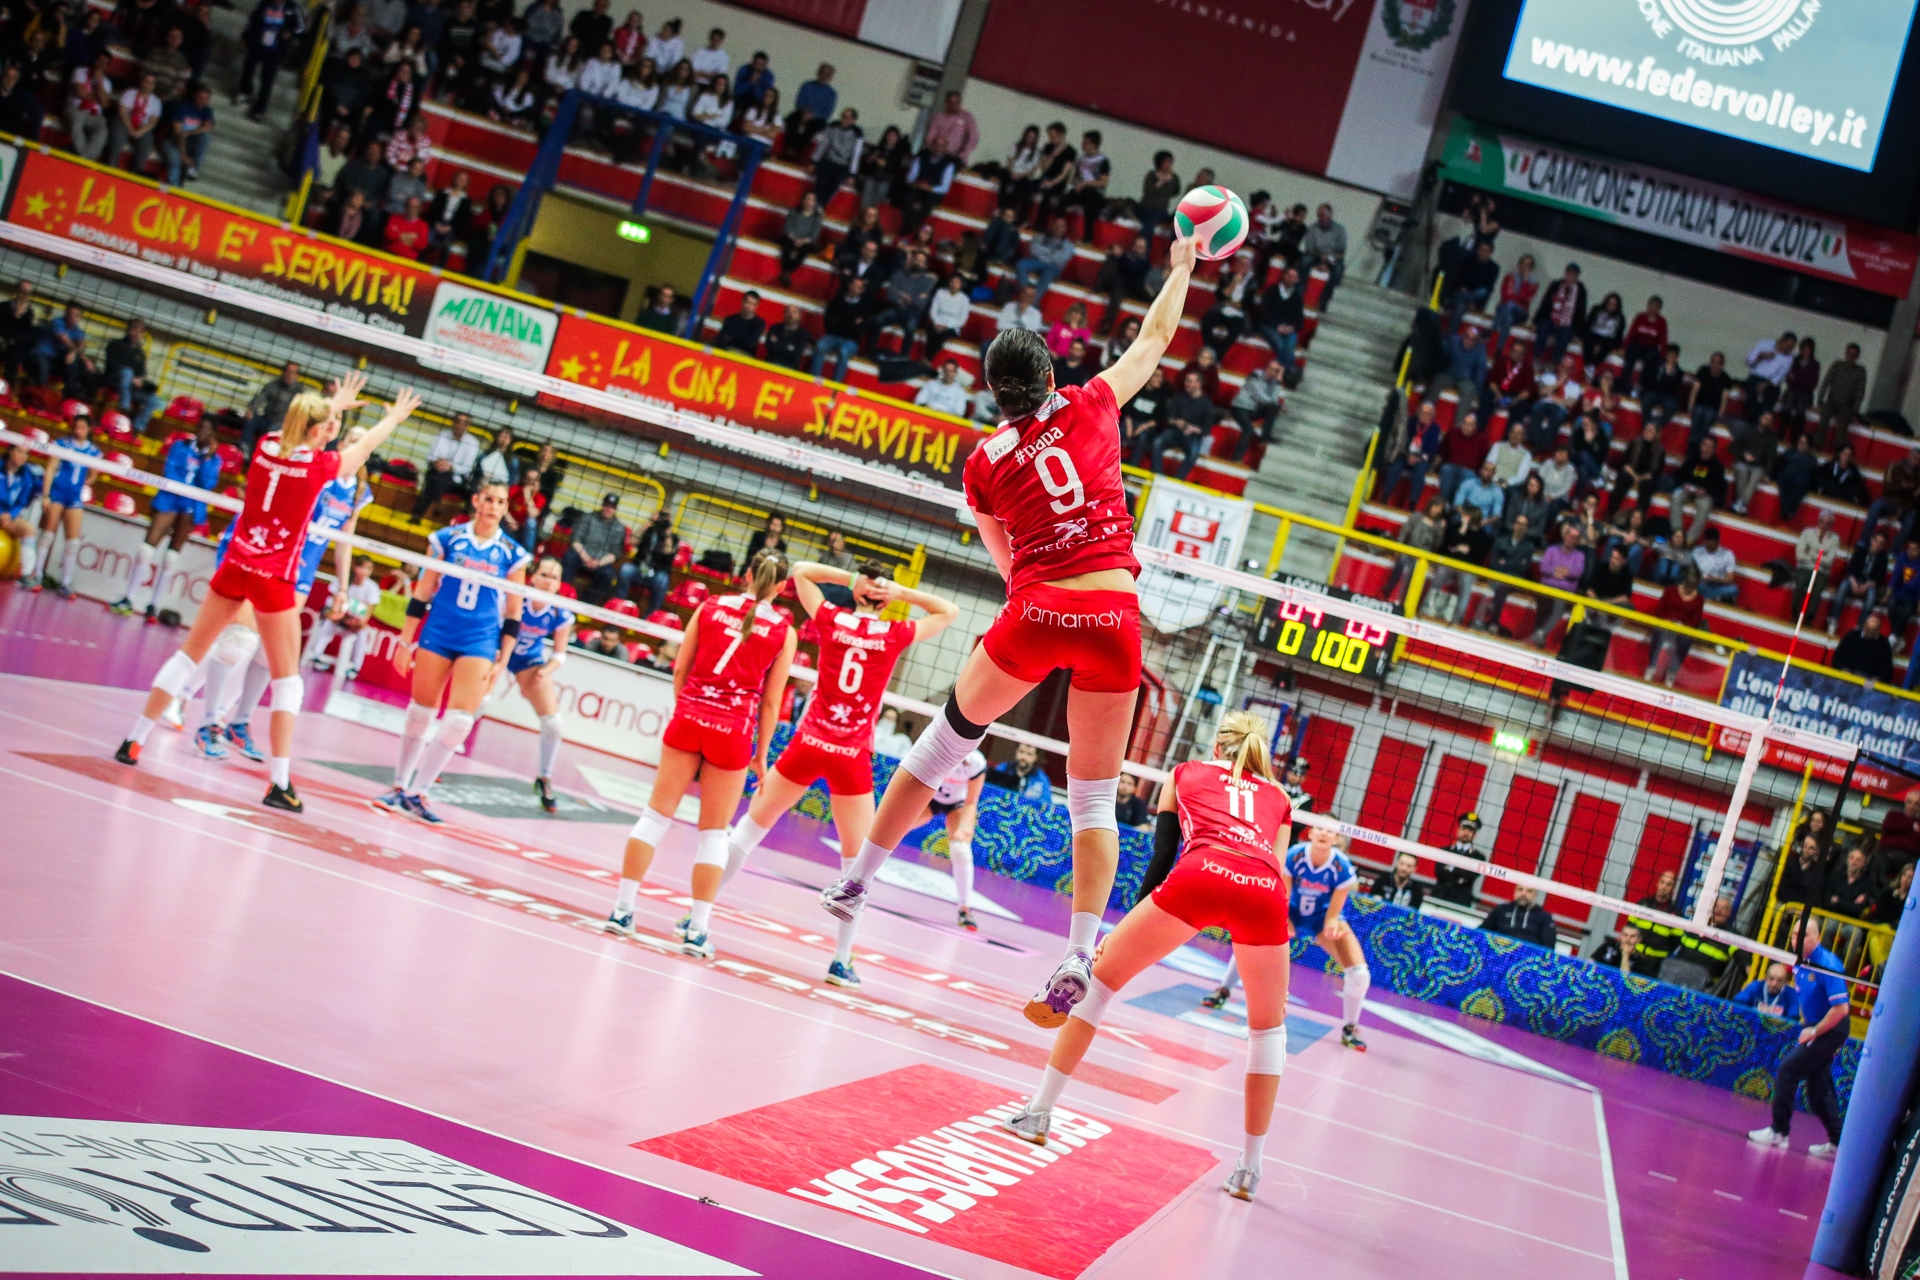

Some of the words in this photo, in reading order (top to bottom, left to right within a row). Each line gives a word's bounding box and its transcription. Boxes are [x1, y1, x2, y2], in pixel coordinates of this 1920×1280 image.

[1156, 0, 1297, 42] IANTANIDA
[1677, 36, 1764, 67] ITALIANA
[1531, 37, 1867, 148] www.federvolley.it
[1527, 149, 1642, 217] CAMPIONE
[1636, 176, 1718, 238] D'ITALIA
[1720, 200, 1823, 264] 2011/2012
[69, 222, 139, 257] MONAVA
[76, 177, 116, 225] LA
[132, 197, 201, 251] CINA
[216, 222, 259, 262] E'
[262, 236, 417, 316] SERVITA!
[438, 298, 543, 346] MONAVA
[610, 339, 651, 387] LA
[668, 357, 738, 411] CINA
[753, 380, 795, 422] E'
[803, 395, 961, 474] SERVITA!
[1015, 426, 1065, 465] #papa
[262, 469, 281, 513] 1
[1034, 446, 1085, 514] 9
[456, 577, 481, 611] 8
[1020, 600, 1123, 630] yamamay
[712, 626, 744, 675] 7
[837, 646, 868, 694] 6
[1736, 668, 1821, 712] L'energia
[1862, 733, 1906, 758] tutti
[1224, 786, 1255, 823] 11
[1339, 824, 1388, 846] SAMSUNG
[1201, 858, 1277, 891] yamamay
[1489, 866, 1507, 879] TIM
[34, 1132, 488, 1178] FEDERAZIONE
[1886, 1152, 1910, 1215] GROUP
[1869, 1217, 1889, 1275] SPORT
